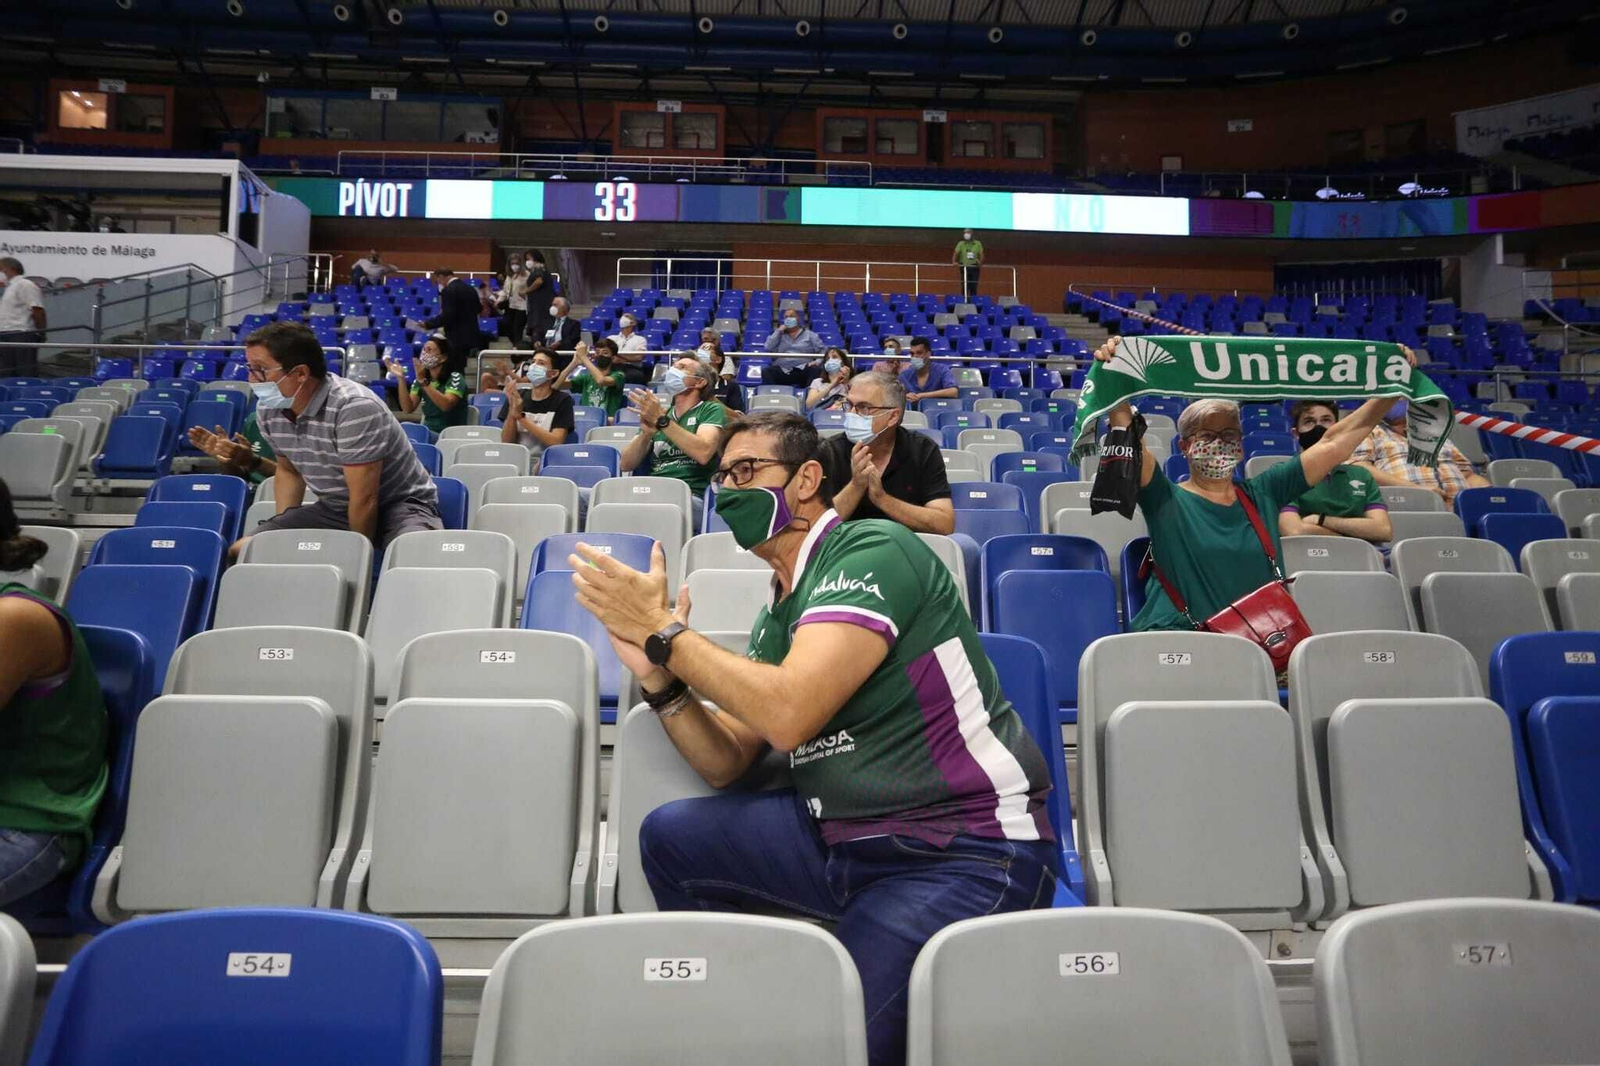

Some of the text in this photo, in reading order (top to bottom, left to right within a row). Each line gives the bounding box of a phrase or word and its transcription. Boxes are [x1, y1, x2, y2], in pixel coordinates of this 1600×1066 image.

[338, 178, 412, 217] PÍVOT
[594, 182, 637, 221] 33
[2, 243, 156, 259] Ayuntamiento de Málaga
[1189, 341, 1412, 391] Unicaja
[303, 542, 316, 550] 52
[267, 649, 286, 660] 53
[489, 652, 507, 662] 54
[1166, 654, 1184, 664] 57
[1371, 653, 1388, 662] 58
[1572, 653, 1589, 663] 59
[835, 744, 855, 754] SPORT
[1468, 946, 1496, 964] 57
[243, 955, 275, 974] 54
[659, 961, 692, 979] 55
[1074, 954, 1105, 974] 56
